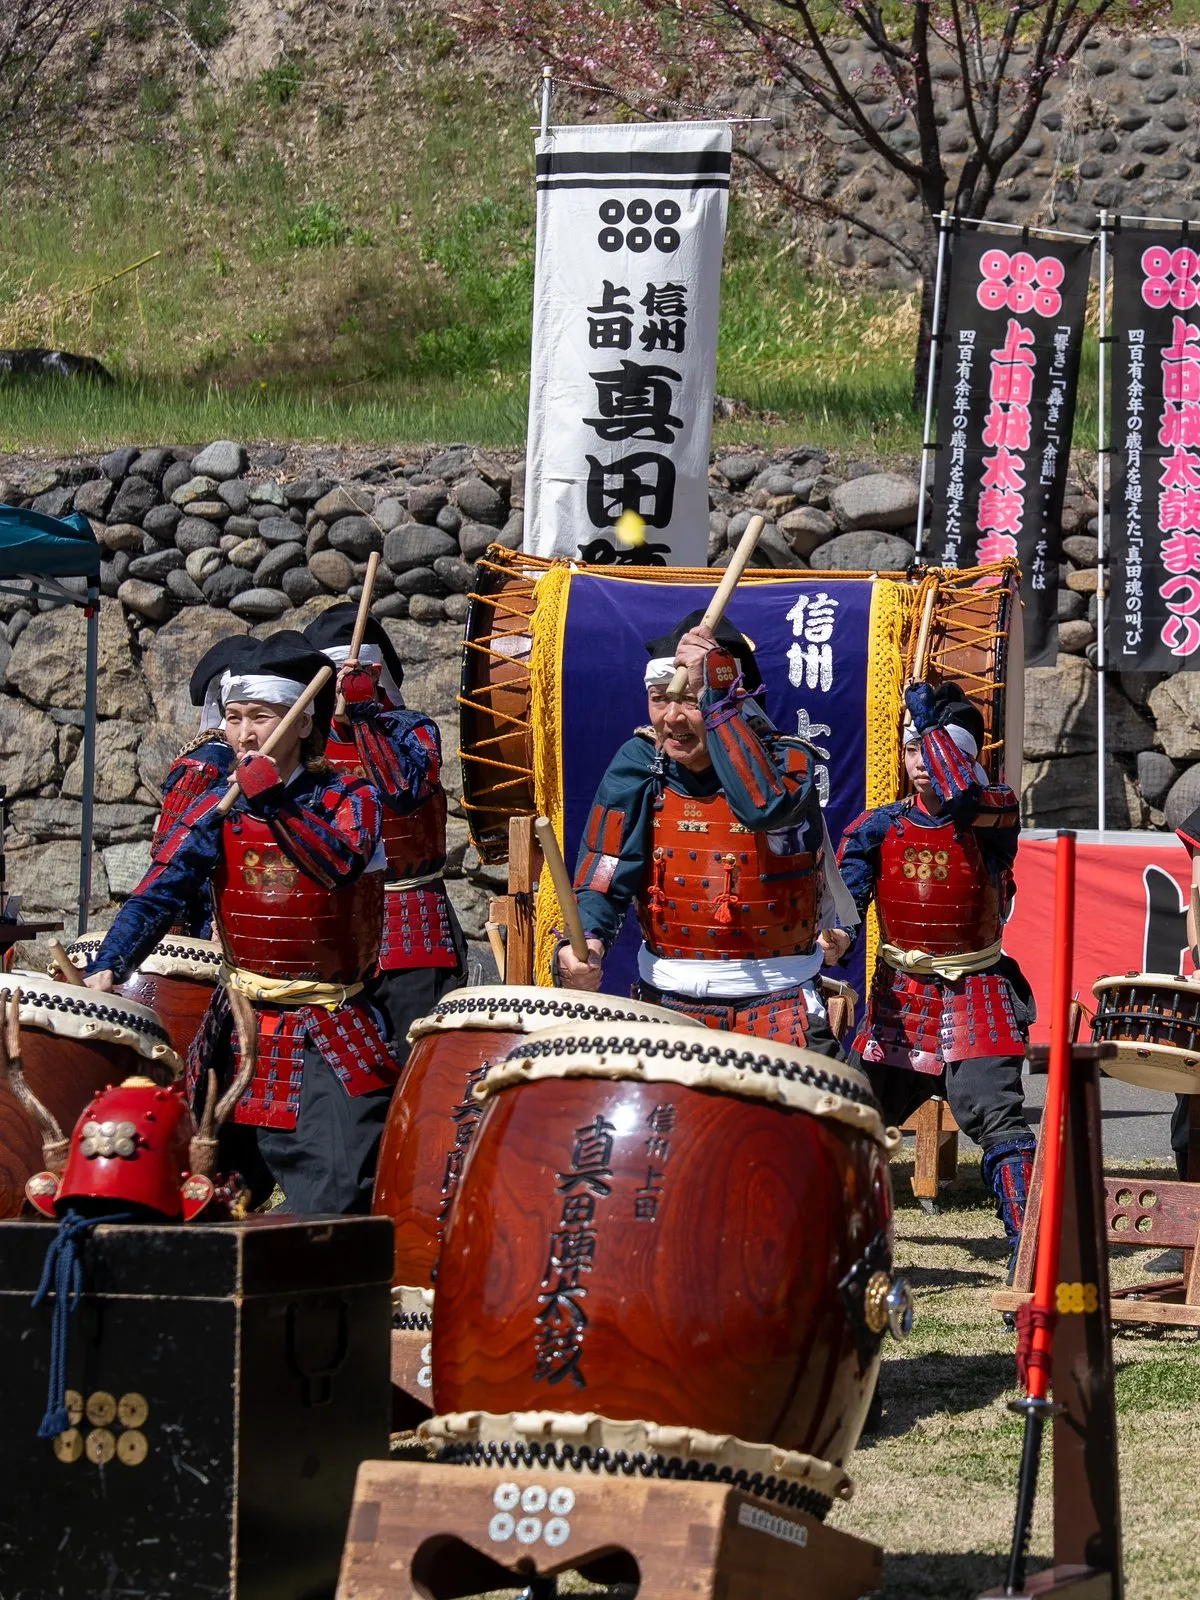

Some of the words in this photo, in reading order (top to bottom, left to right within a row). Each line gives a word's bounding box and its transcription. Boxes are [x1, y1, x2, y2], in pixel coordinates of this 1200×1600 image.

[587, 279, 634, 351] 上田
[639, 281, 688, 355] 信州
[577, 359, 685, 567] 真田
[532, 1114, 617, 1391] 真田陣太鼓
